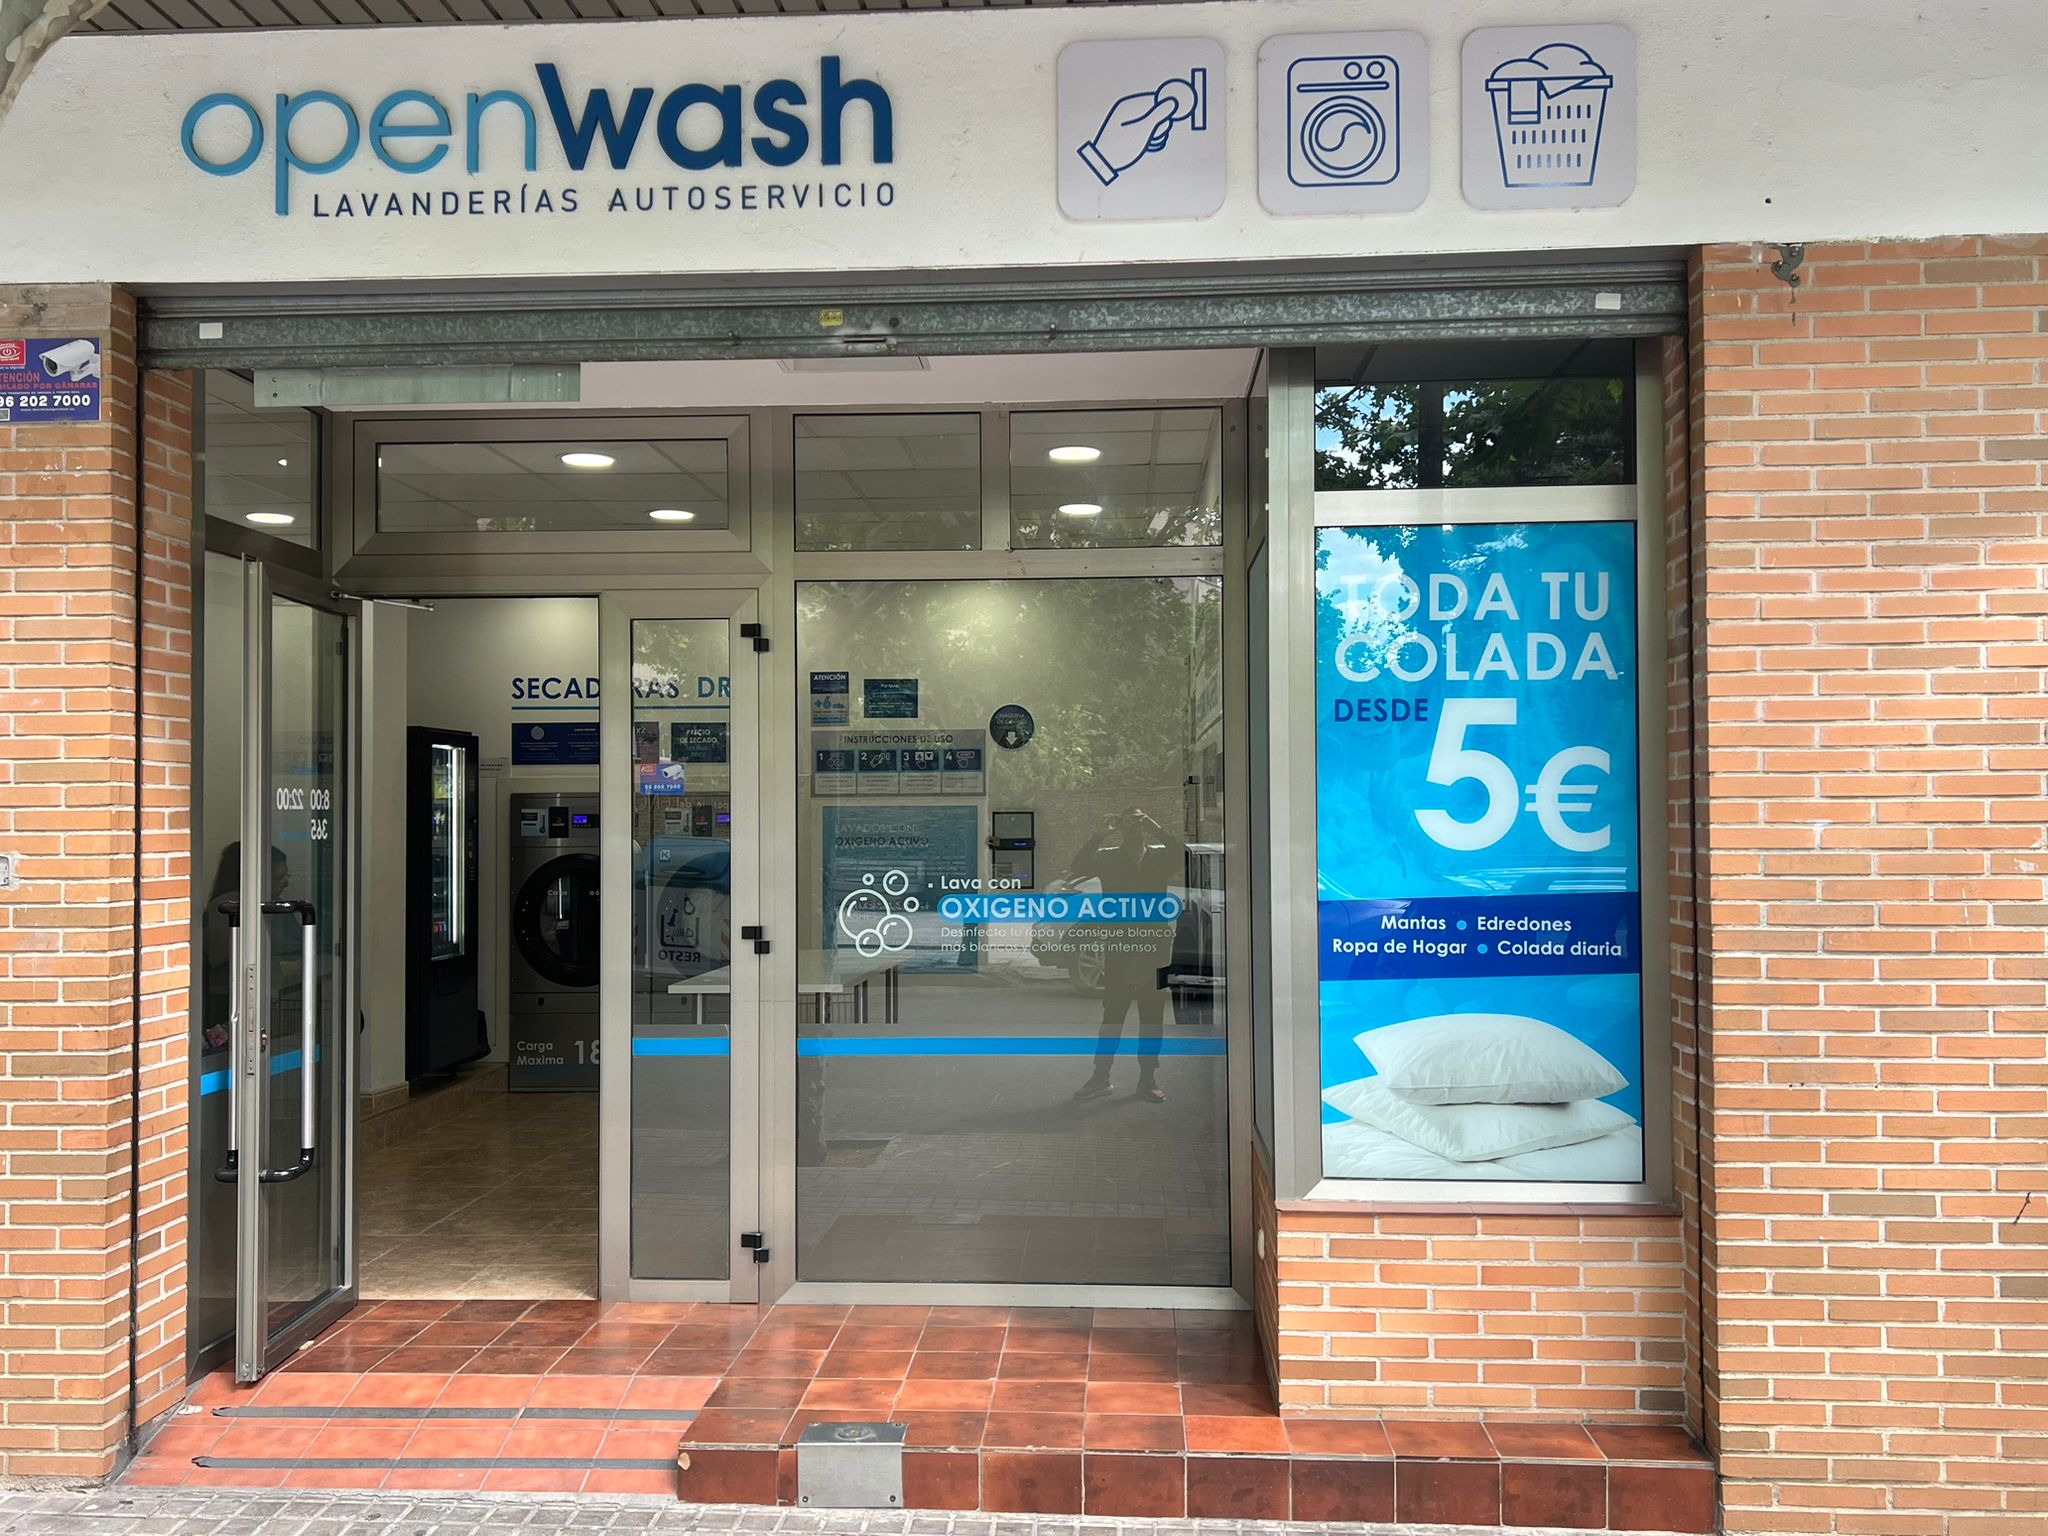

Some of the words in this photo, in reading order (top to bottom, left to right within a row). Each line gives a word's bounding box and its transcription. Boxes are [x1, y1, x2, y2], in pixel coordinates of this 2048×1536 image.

[180, 56, 893, 216] openwash
[313, 184, 579, 218] LAVANDERÍAS
[609, 182, 896, 213] AUTOSERVICIO
[19, 395, 48, 407] 202
[52, 394, 91, 406] 7000
[1339, 572, 1520, 621] TODA
[1541, 572, 1610, 621] TU
[1334, 632, 1619, 682] COLADA
[813, 673, 846, 681] ATENCIÓN
[511, 677, 680, 699] SECADRAS
[1335, 698, 1429, 723] DESDE
[843, 735, 917, 744] INSTRUCCIONES
[934, 735, 953, 743] USO
[861, 752, 867, 761] 2
[903, 752, 910, 761] 3
[945, 752, 953, 761] 4
[941, 876, 982, 889] Lava
[988, 878, 1021, 889] con
[941, 897, 1069, 919] OXIGENO
[1077, 897, 1180, 919] ACTIVO
[1381, 914, 1447, 931] Mantas
[1477, 916, 1572, 932] Edredones
[941, 927, 1006, 937] Desinfecta
[1010, 928, 1022, 937] tu
[1025, 929, 1055, 939] ropa
[1068, 927, 1124, 939] consigue
[1127, 927, 1177, 938] blancos
[941, 942, 966, 952] más
[970, 942, 1018, 952] blancos
[1031, 942, 1076, 953] colores
[1080, 941, 1105, 953] más
[1107, 942, 1157, 953] intensos
[1333, 938, 1381, 957] Ropa
[1384, 939, 1407, 954] de
[1412, 939, 1467, 959] Hogar
[1497, 940, 1567, 956] Colada
[1571, 941, 1623, 957] diaria
[516, 1040, 553, 1053] Carga
[516, 1055, 564, 1065] Maxima
